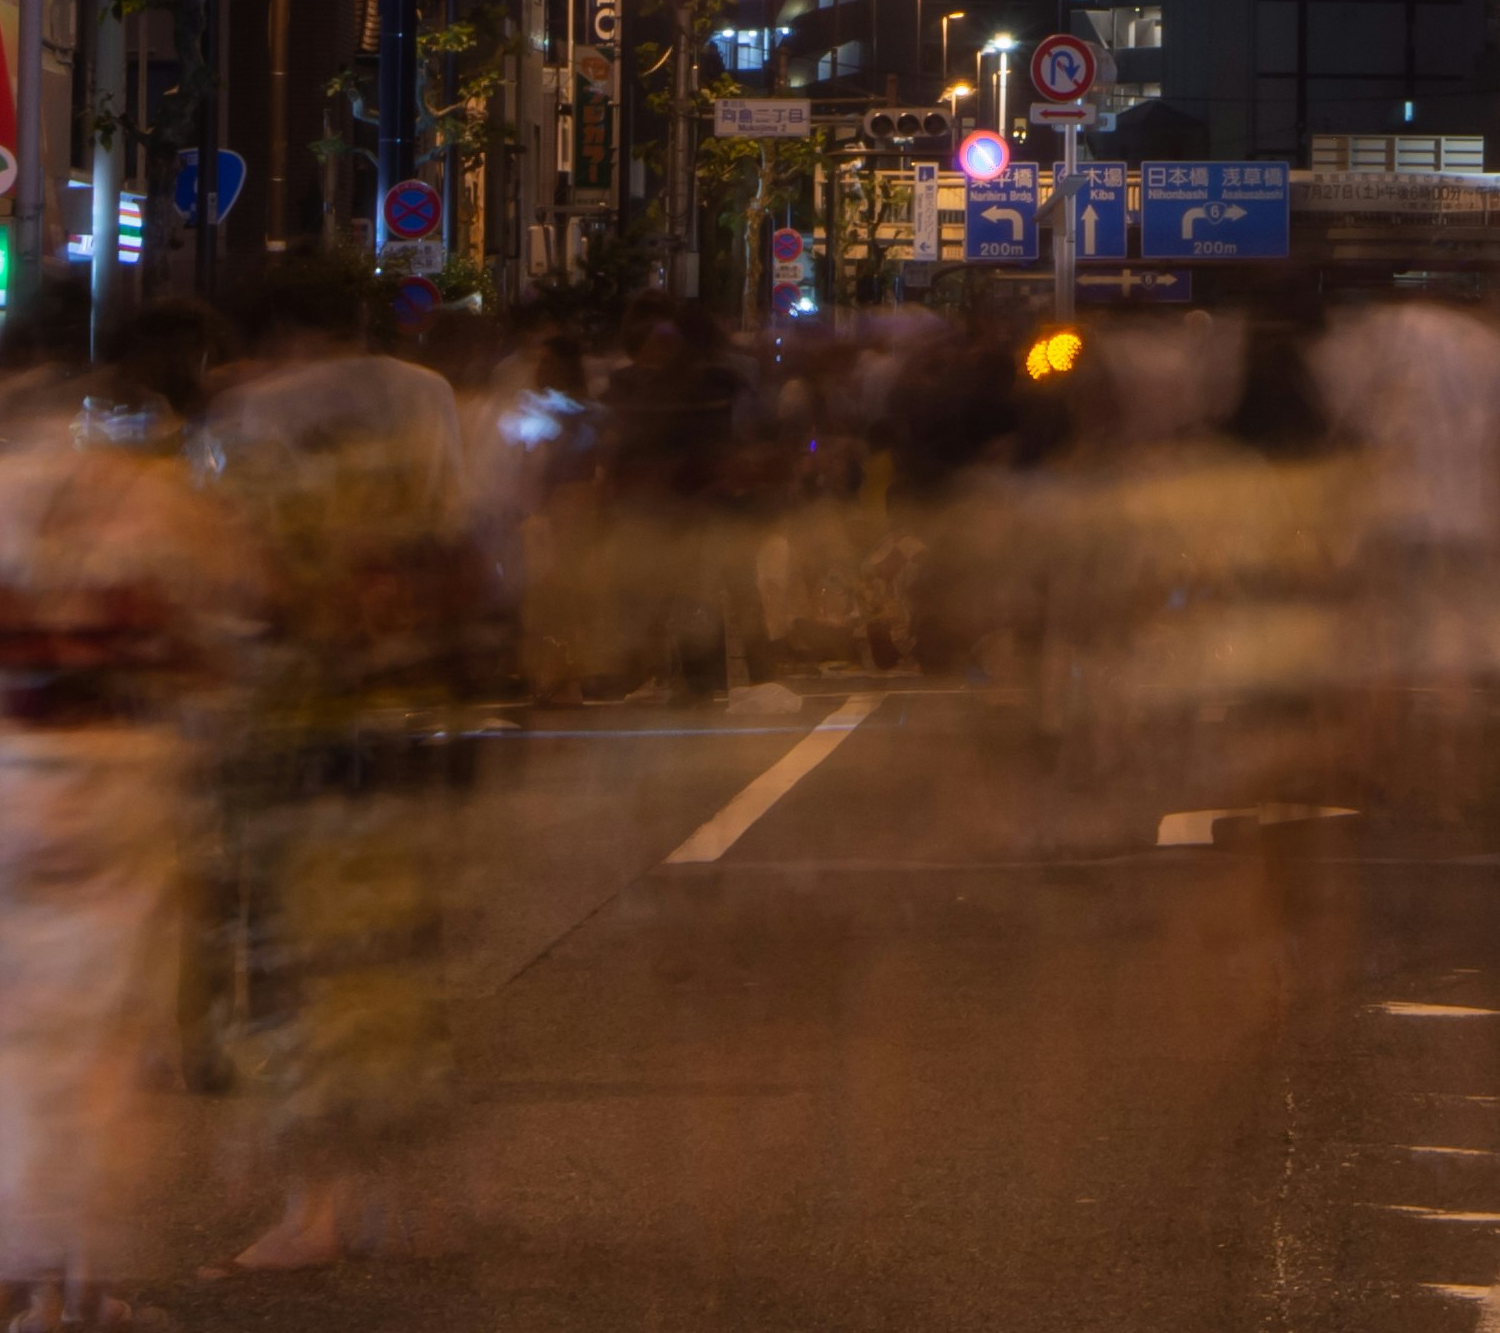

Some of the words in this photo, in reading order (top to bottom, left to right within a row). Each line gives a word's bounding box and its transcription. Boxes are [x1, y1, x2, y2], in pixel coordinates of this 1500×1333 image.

[1084, 168, 1122, 187] 木場
[1148, 167, 1209, 188] 日本橋
[1222, 167, 1283, 188] 浅草橋
[970, 190, 1007, 201] Narihira
[1010, 190, 1034, 203] Brdg.
[1090, 190, 1115, 200] Kiba
[1148, 190, 1208, 200] Nihonbashi
[1221, 189, 1284, 200] Asakusabashi
[1210, 205, 1220, 218] 6
[980, 243, 1024, 256] 200m
[1193, 241, 1238, 255] 200m
